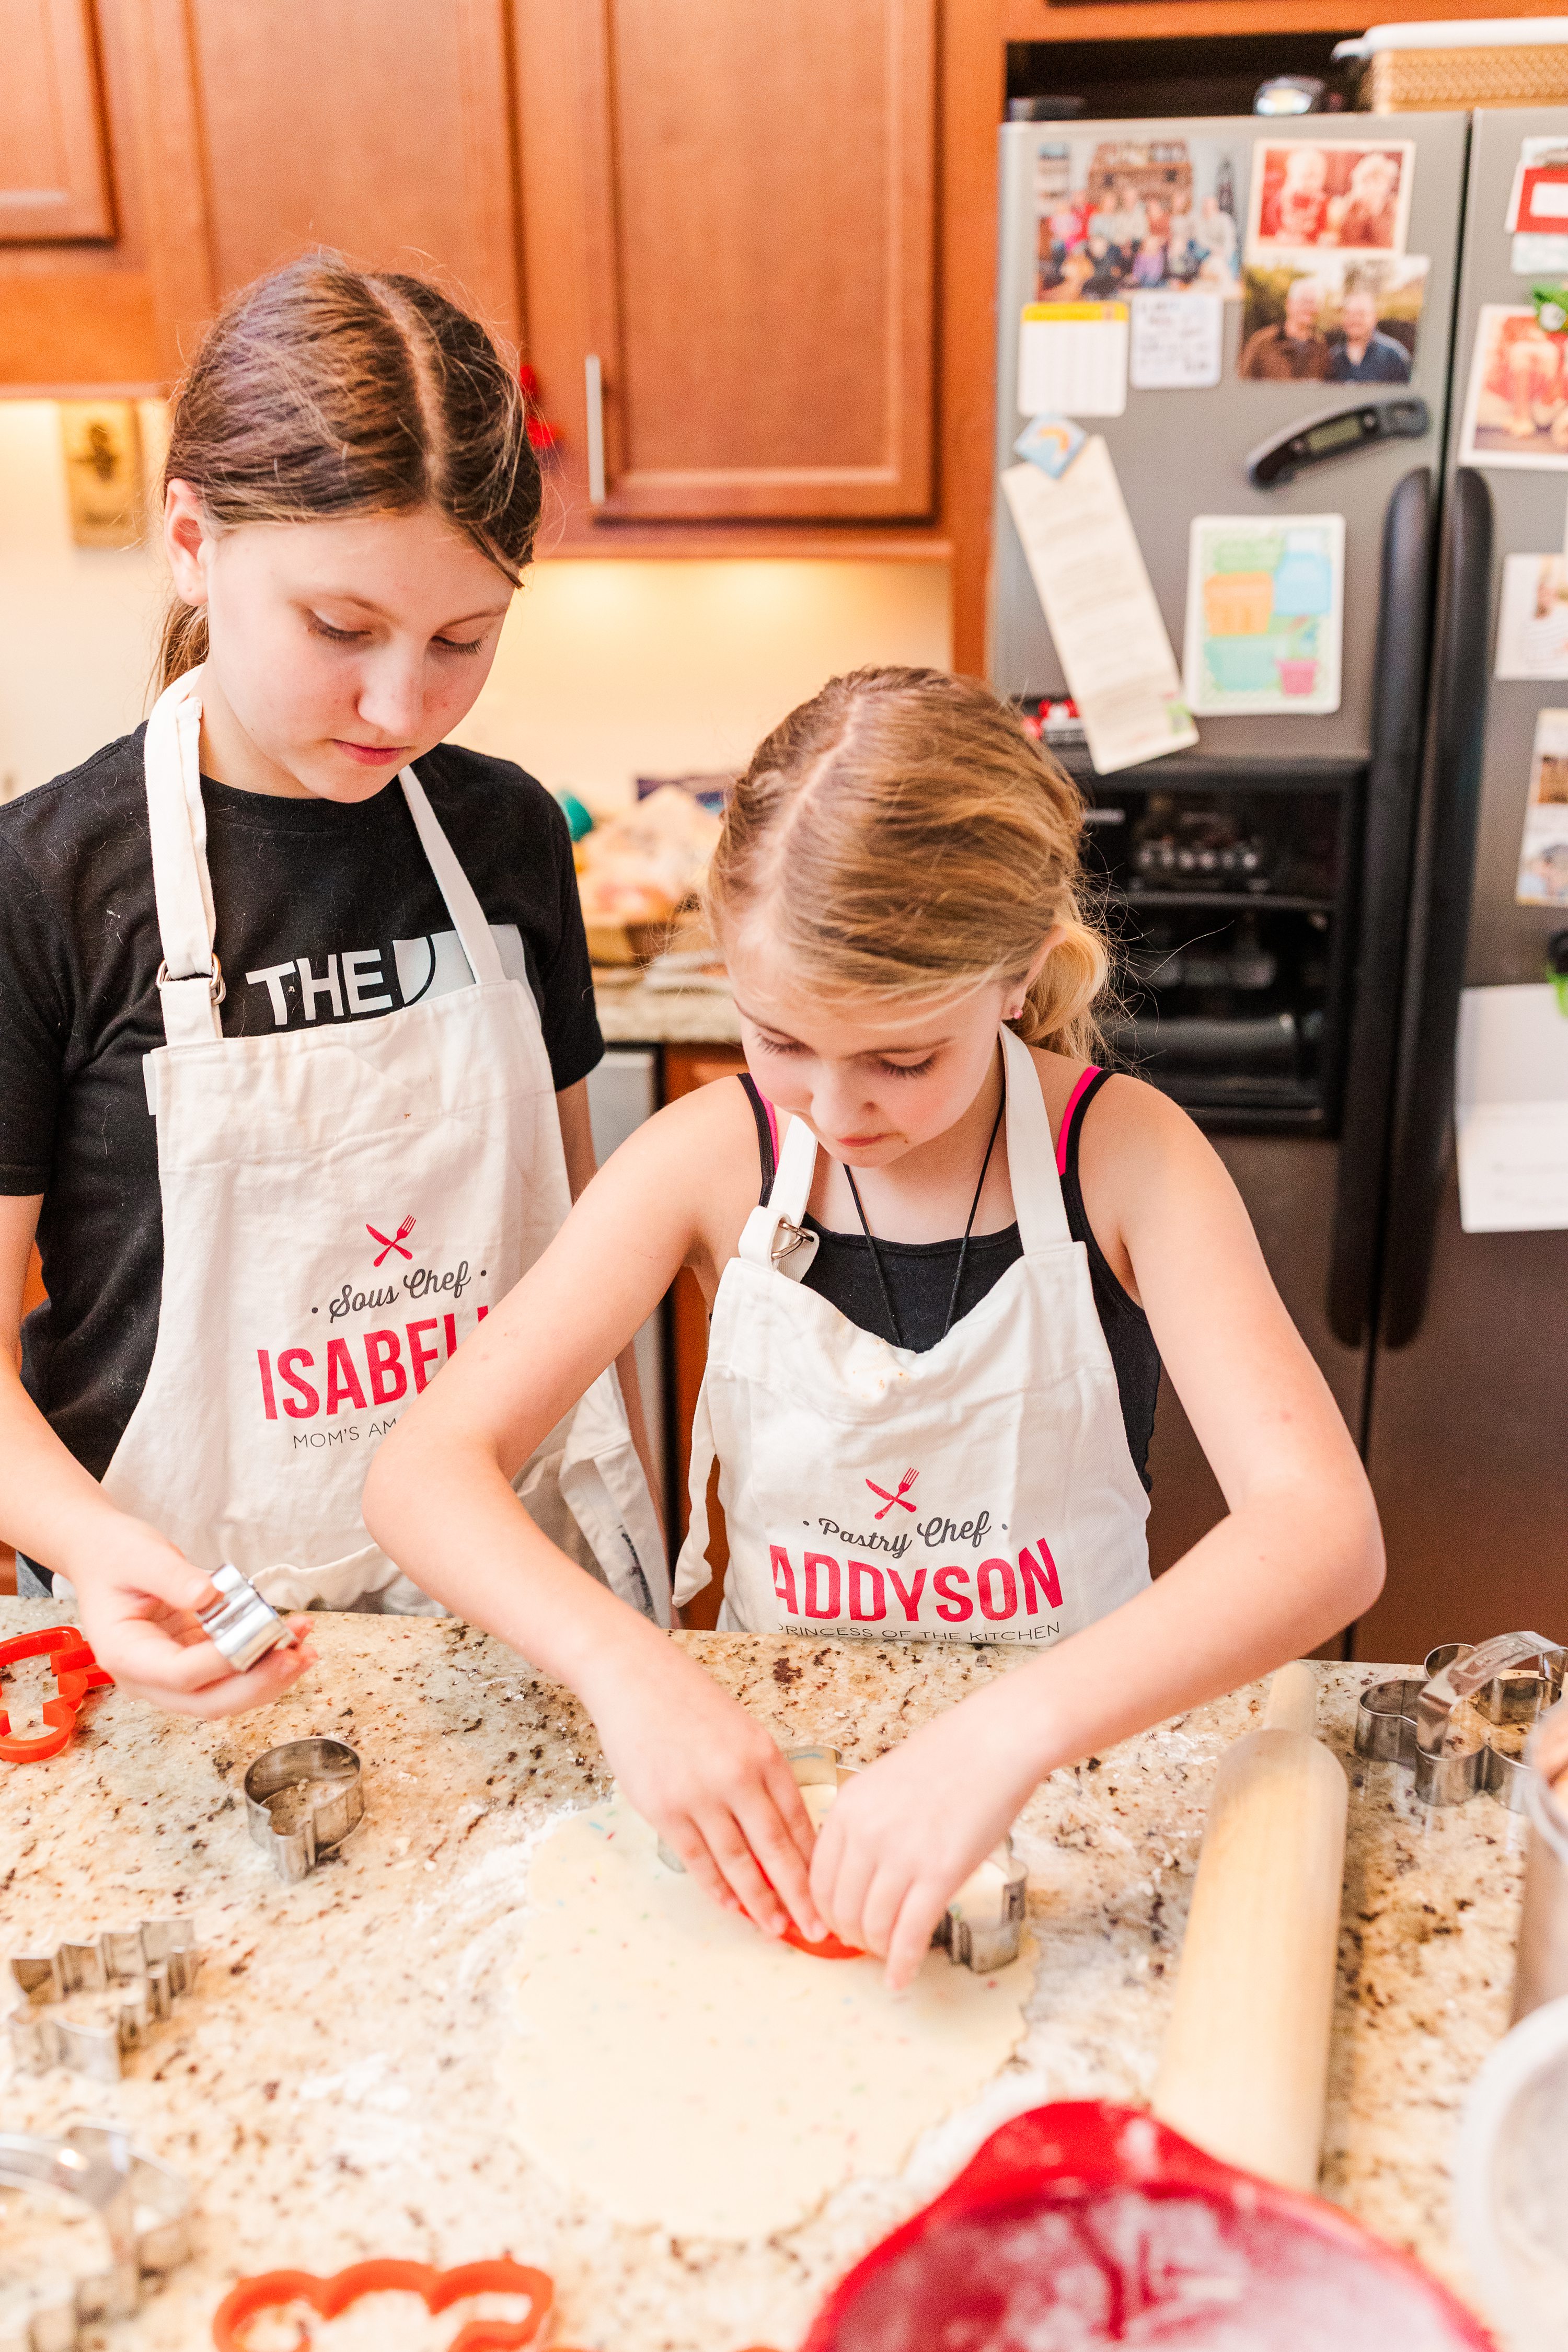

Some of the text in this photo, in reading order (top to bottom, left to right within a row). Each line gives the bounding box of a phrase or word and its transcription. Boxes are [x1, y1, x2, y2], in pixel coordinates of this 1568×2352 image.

[245, 949, 393, 1025] THE
[329, 1261, 471, 1323] Sous Chef
[257, 1305, 488, 1420] ISABE
[293, 1418, 396, 1449] MOM'S AM
[818, 1511, 991, 1559] Pastry Chef
[769, 1538, 1063, 1622] ADDYSON
[778, 1622, 873, 1638] RINCESS
[919, 1631, 961, 1640] THE
[970, 1621, 1060, 1641] KITCHEN
